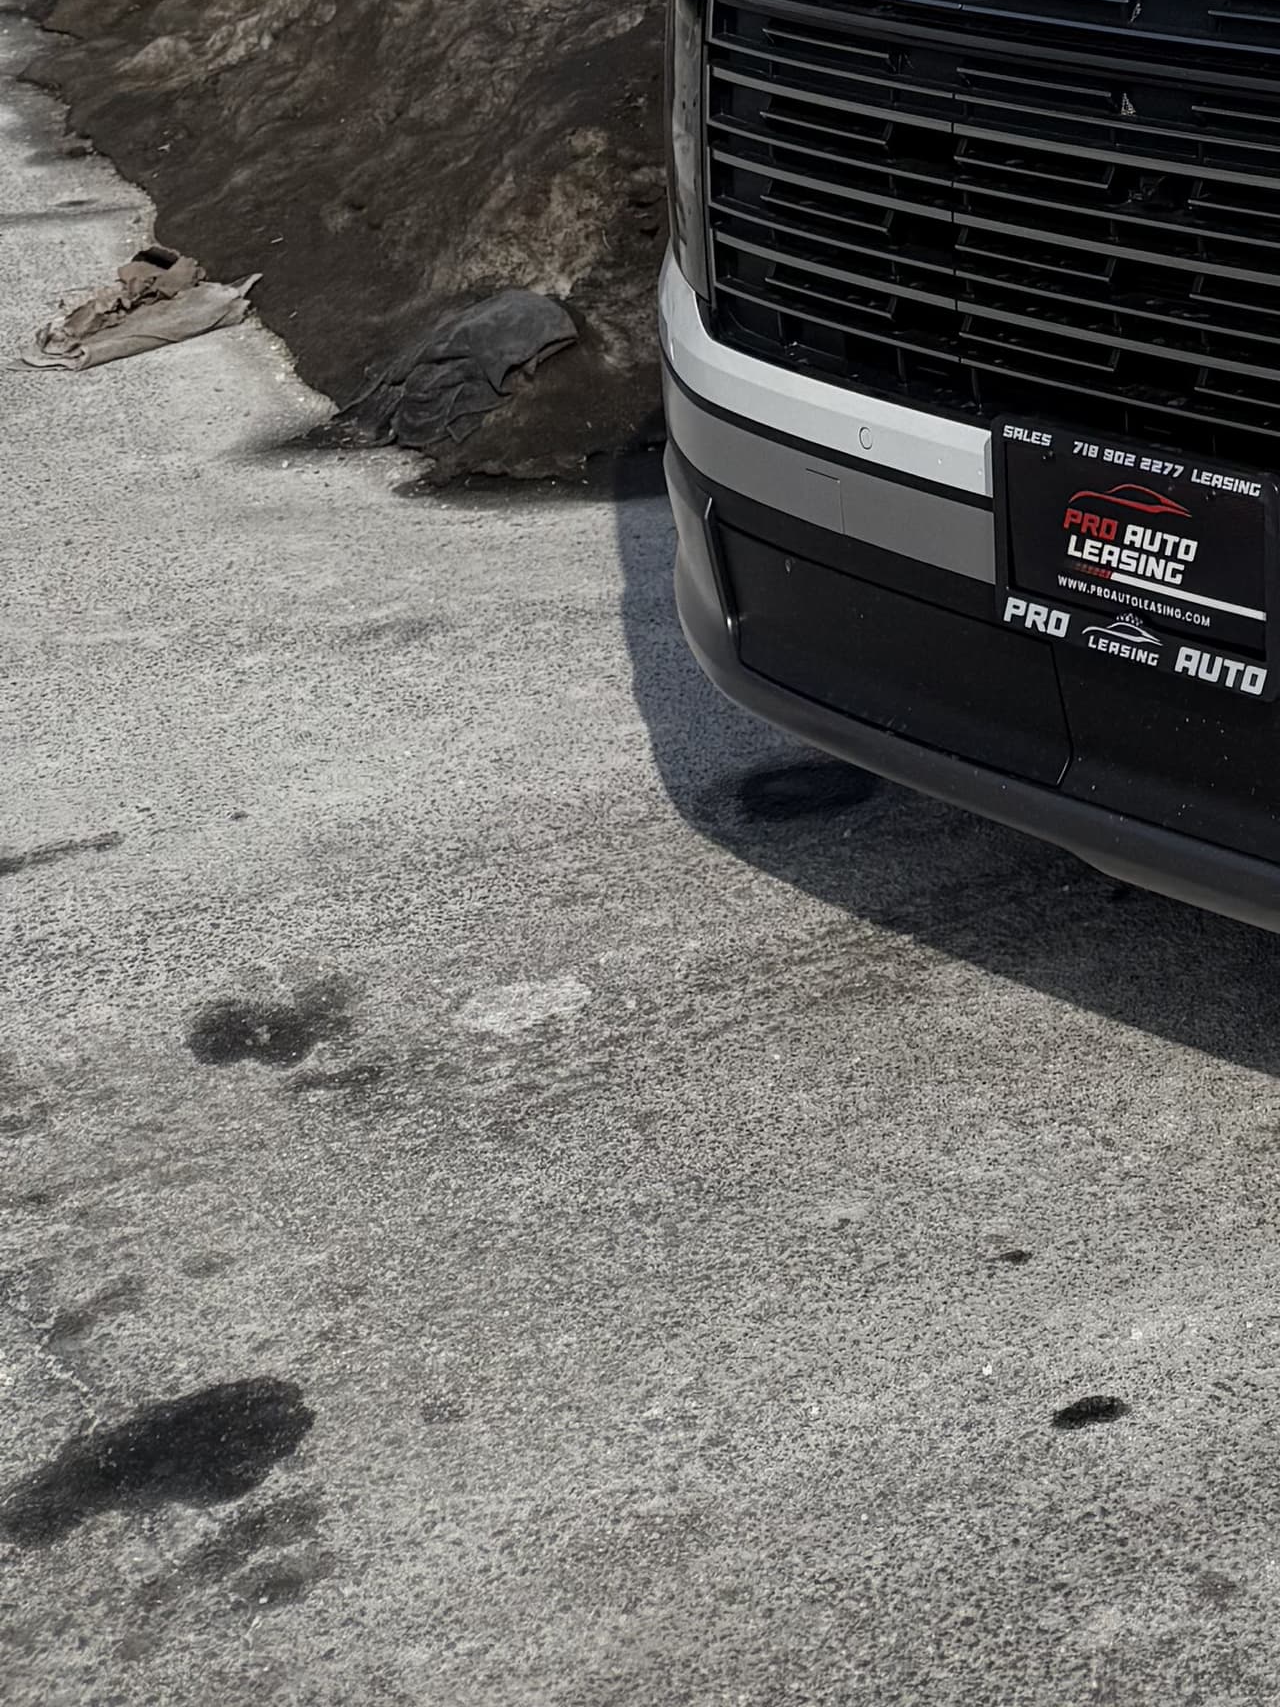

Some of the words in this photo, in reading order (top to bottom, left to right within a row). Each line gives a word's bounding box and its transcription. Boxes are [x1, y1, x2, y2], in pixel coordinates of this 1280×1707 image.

[1002, 425, 1052, 446] SALES
[1072, 441, 1098, 458] 718
[1103, 449, 1135, 467] 902
[1140, 457, 1184, 479] 2277
[1191, 469, 1262, 498] LEASING
[1063, 507, 1118, 541] PRO
[1123, 524, 1198, 563] AUTO
[1067, 535, 1185, 586] LEASING
[1057, 574, 1211, 628] WWW.PROAUTOLEASING.COM
[1003, 596, 1070, 638] PRO
[1087, 636, 1159, 667] LEASING
[1174, 646, 1267, 696] AUTO
